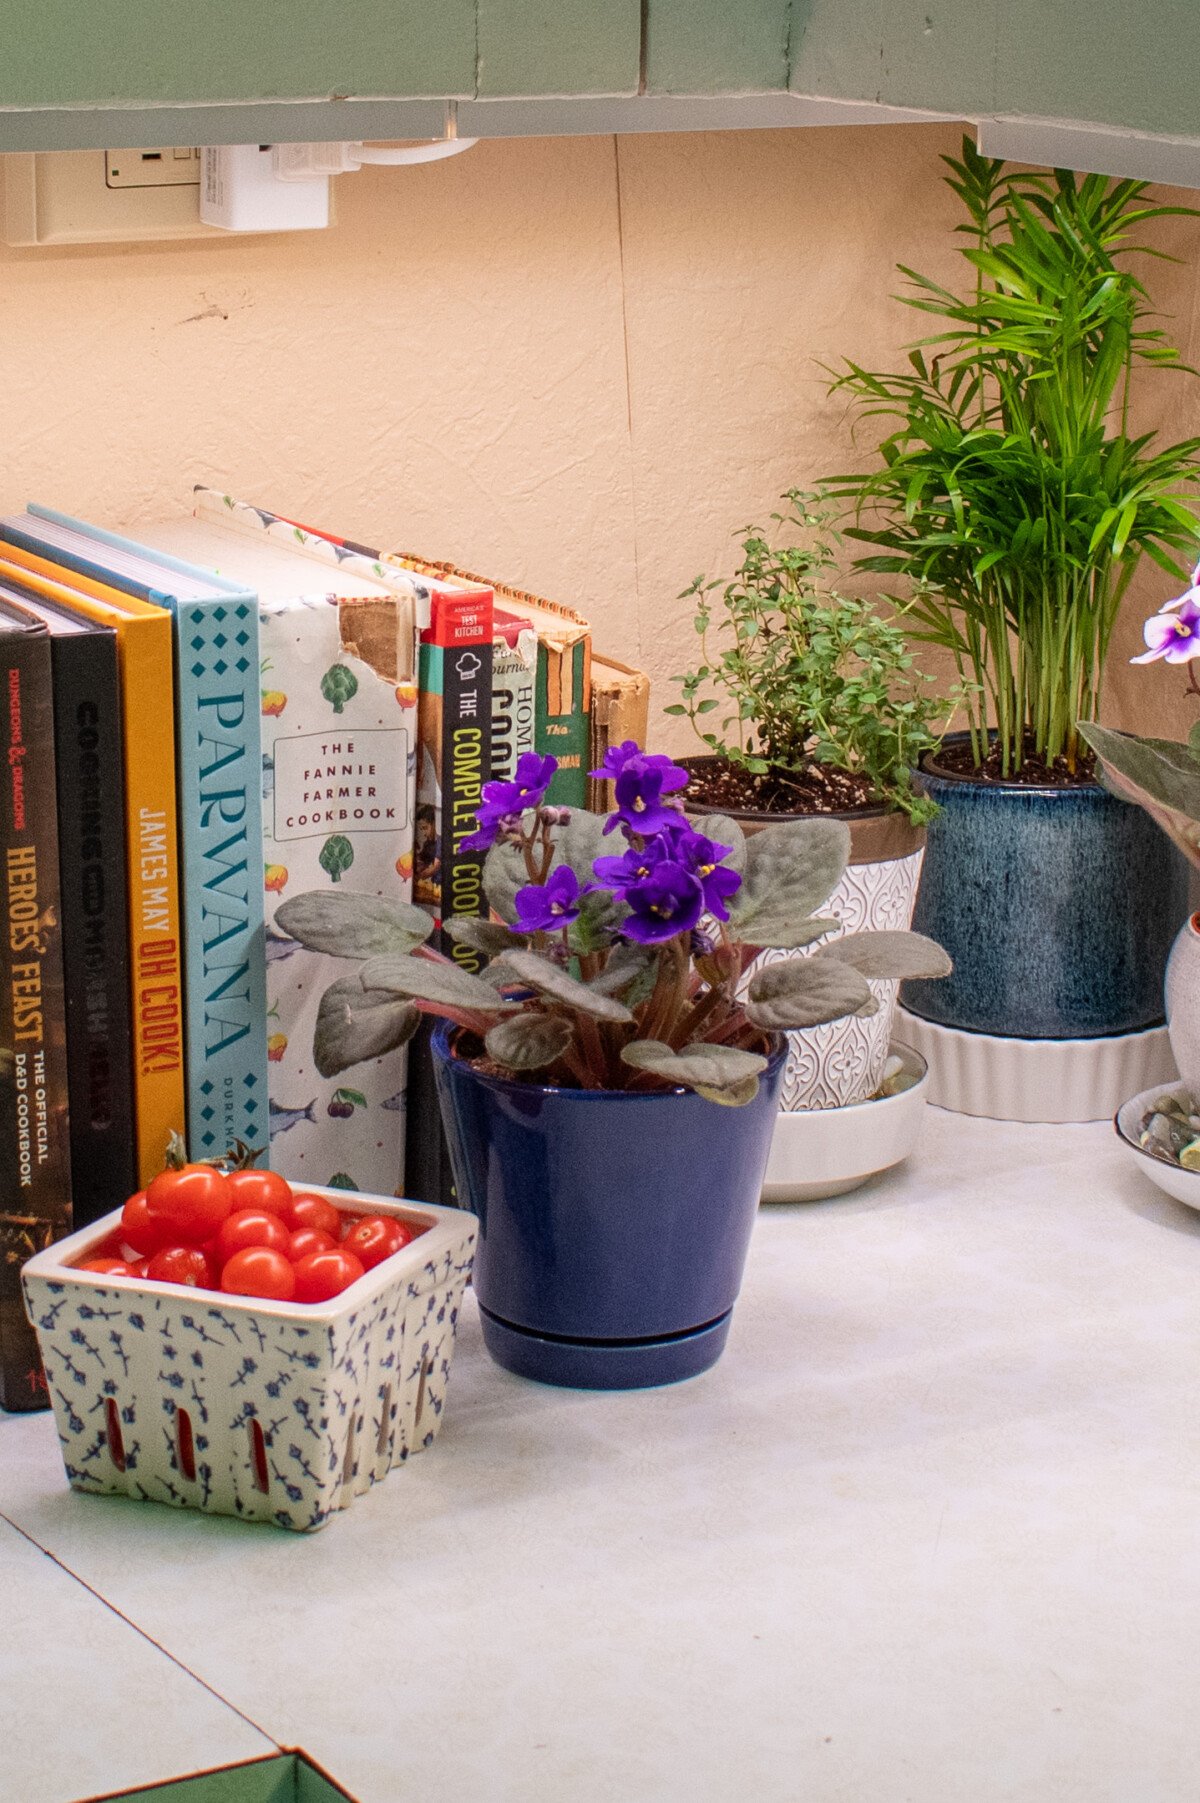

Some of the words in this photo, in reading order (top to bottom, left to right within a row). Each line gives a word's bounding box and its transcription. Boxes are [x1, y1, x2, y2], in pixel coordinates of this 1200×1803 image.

[455, 625, 484, 638] KITCHEN
[462, 614, 477, 626] TEST
[9, 668, 22, 748] DUNGEONS
[460, 688, 478, 719] THE
[321, 743, 355, 755] THE
[304, 765, 377, 780] FANNIE
[453, 727, 482, 855] COMPLET
[12, 766, 26, 830] DRAGONS
[303, 787, 377, 803] FARMER
[286, 808, 396, 828] COOKBOOK
[140, 808, 168, 881] JAMES
[197, 689, 252, 1062] PARWANA
[142, 888, 170, 931] MAY
[139, 938, 177, 978] OH
[12, 962, 43, 1042] FEAST
[140, 984, 180, 1076] COOK!
[15, 1053, 27, 1090] D&D
[34, 1050, 46, 1085] THE
[36, 1088, 48, 1165] OFFICIAL
[223, 1077, 235, 1149] DURKHA
[17, 1094, 32, 1186] COOKBOOK
